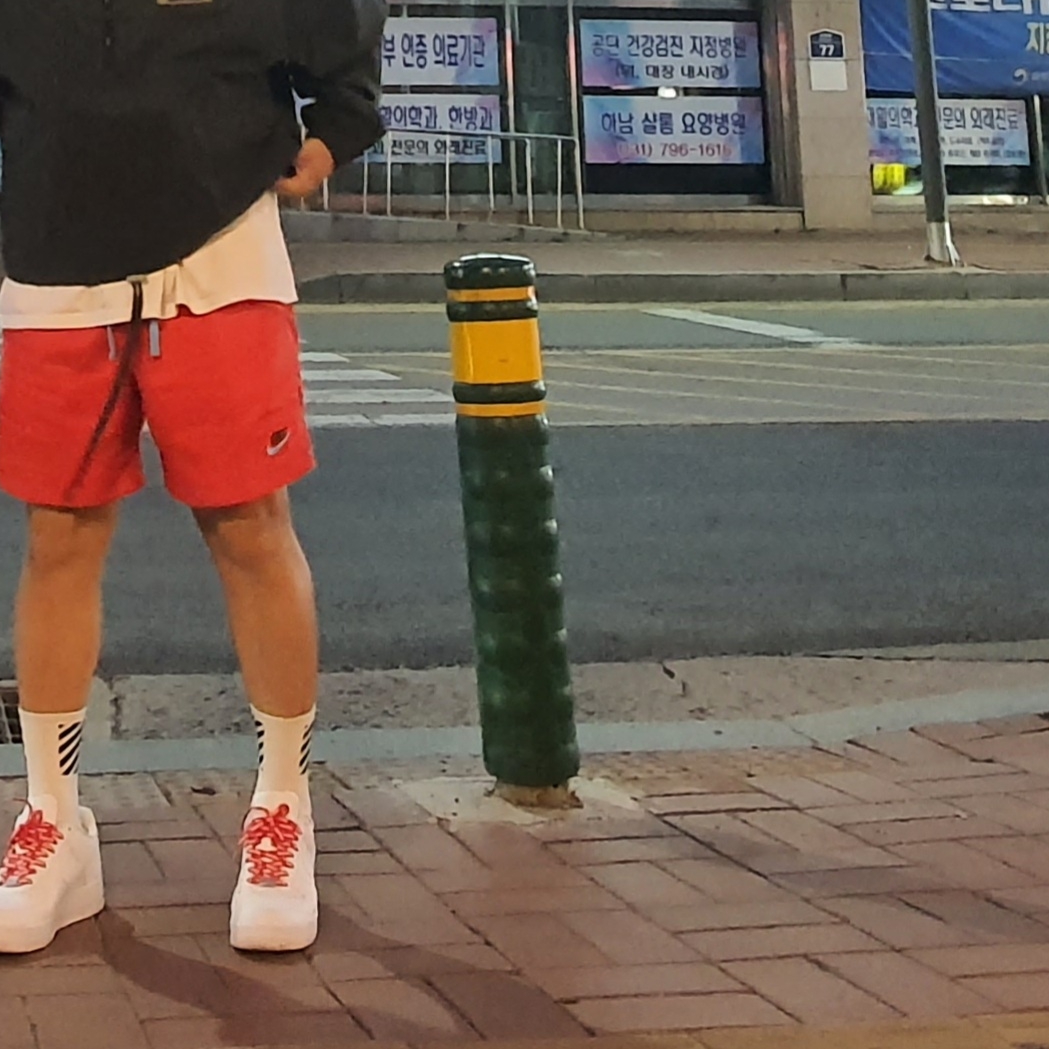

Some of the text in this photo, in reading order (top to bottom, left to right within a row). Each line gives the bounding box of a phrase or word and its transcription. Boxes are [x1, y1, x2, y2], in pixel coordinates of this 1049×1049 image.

[401, 33, 428, 69] 인증
[433, 33, 486, 69] 의료기관
[592, 34, 747, 59] 공단 건강검진 지정병원
[818, 44, 836, 57] 77
[645, 64, 675, 80] 대장
[680, 64, 730, 81] 내시경)
[601, 111, 635, 136] 하남
[681, 112, 746, 136] 요양병원
[938, 108, 966, 131] 문의
